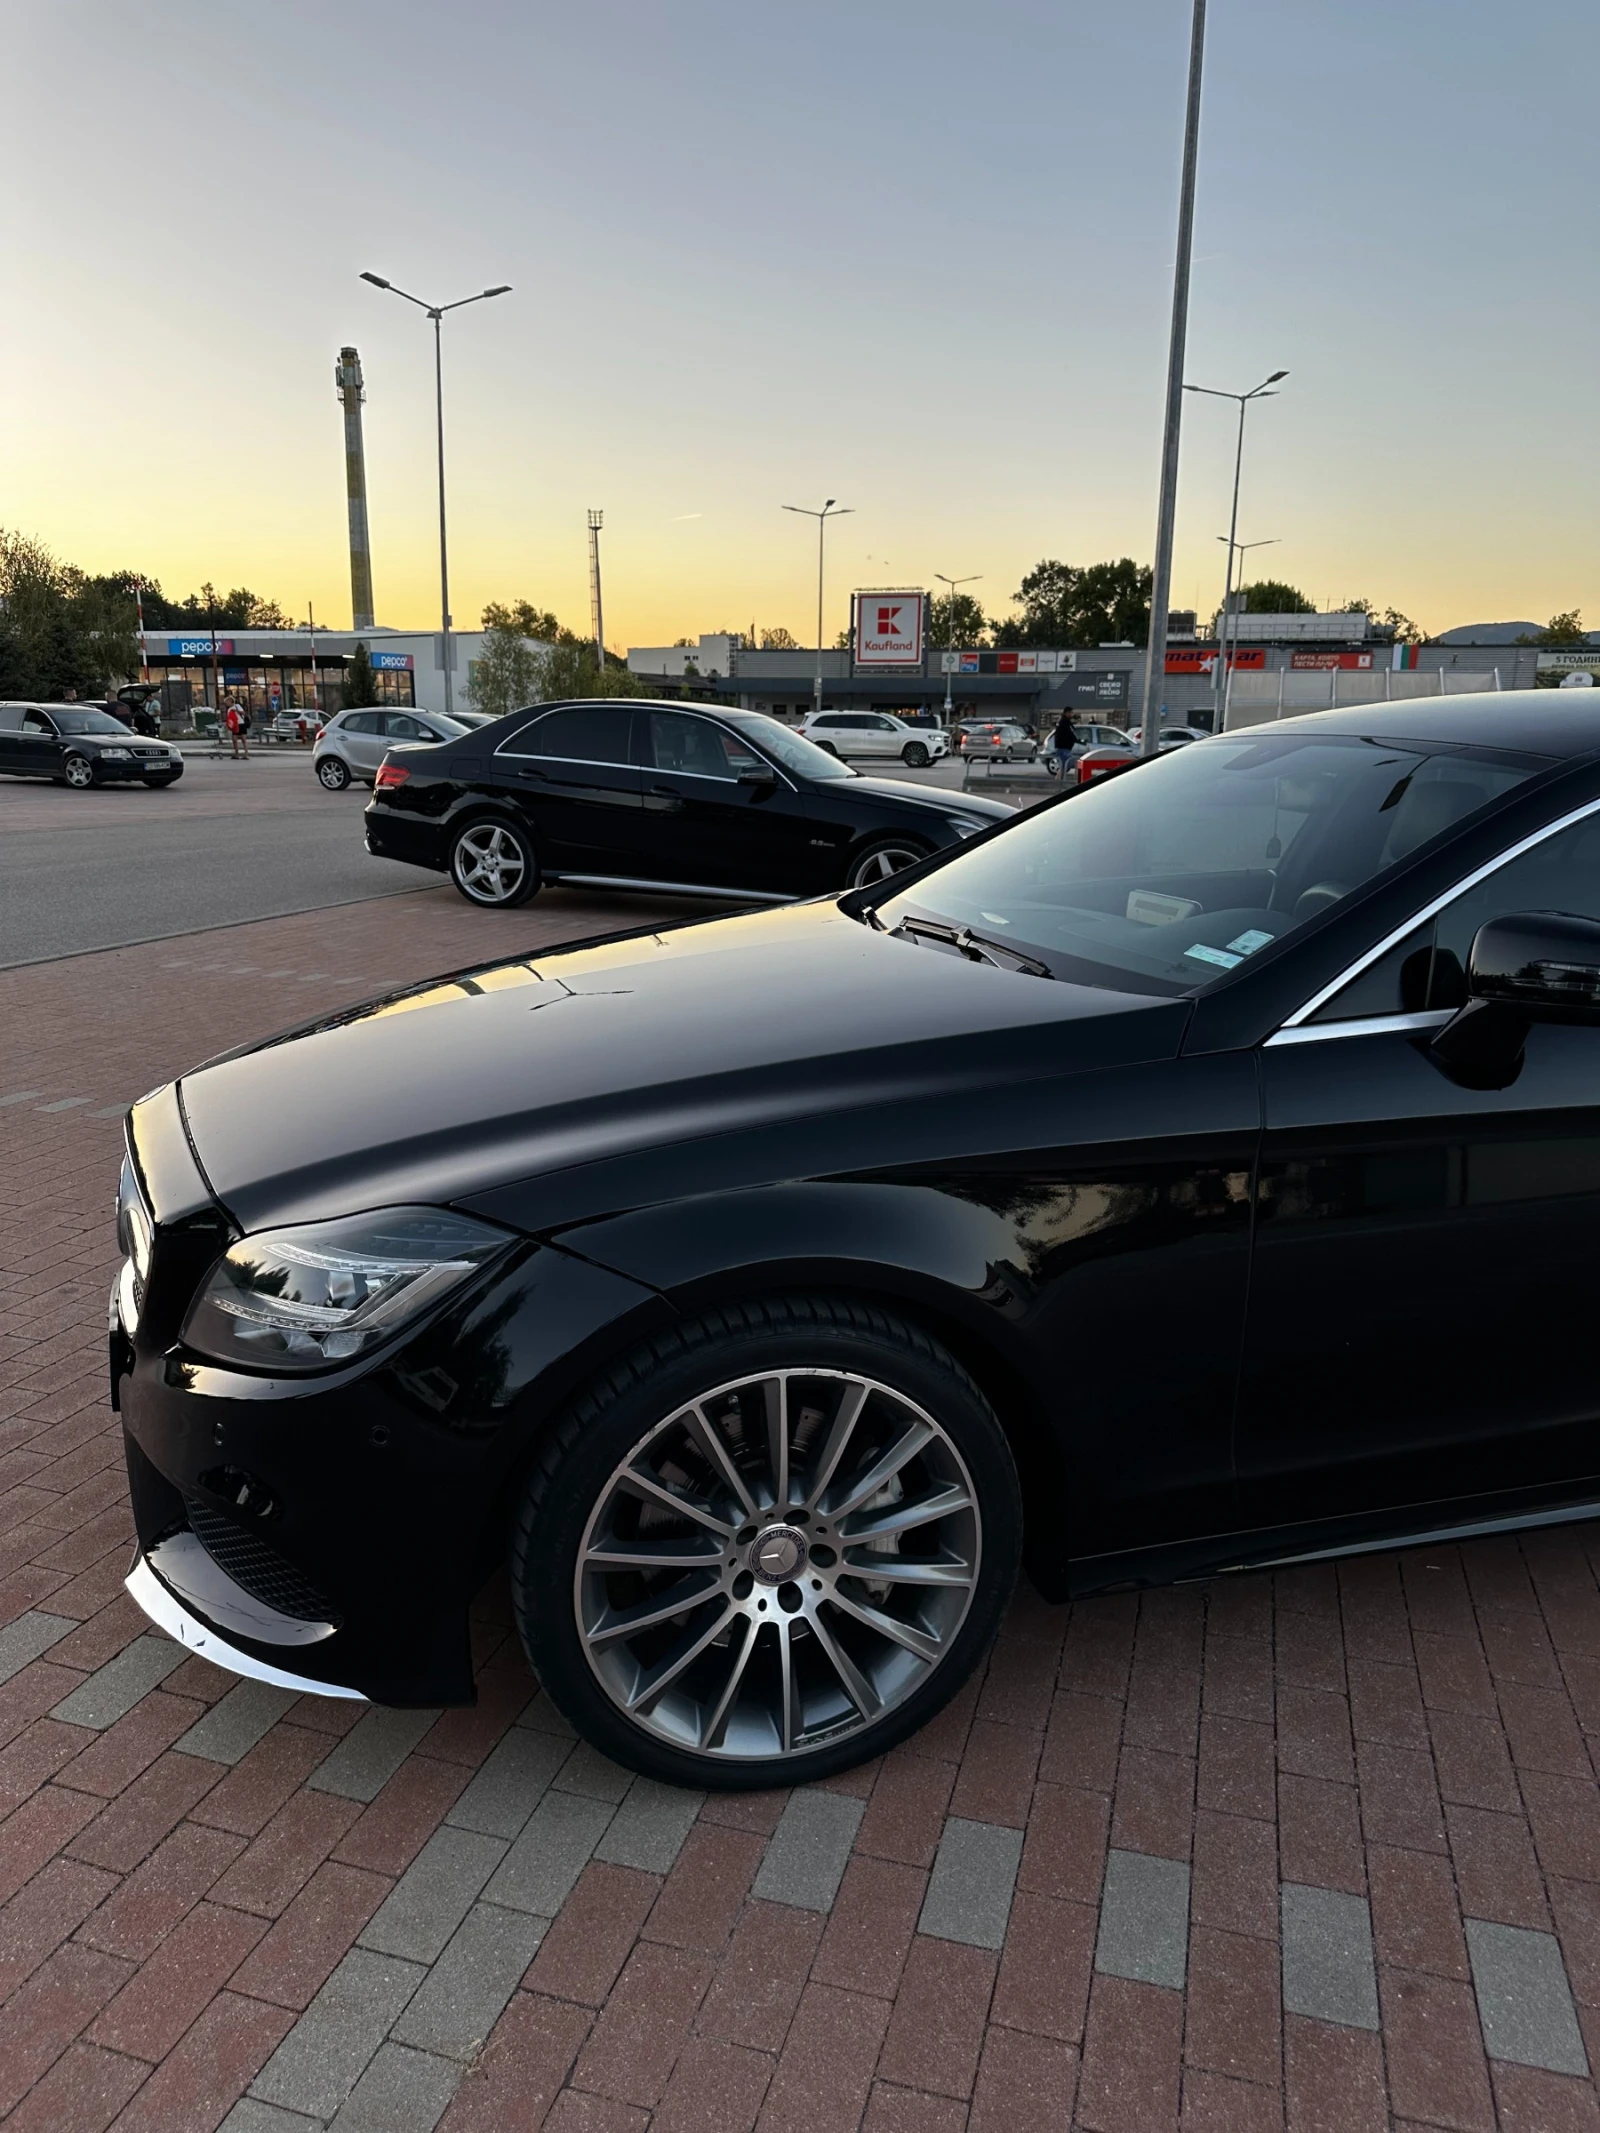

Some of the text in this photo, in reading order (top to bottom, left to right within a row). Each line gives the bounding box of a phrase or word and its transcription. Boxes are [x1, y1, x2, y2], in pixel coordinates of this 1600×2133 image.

[181, 641, 219, 653] pepco
[865, 640, 913, 651] Kaufland
[381, 656, 406, 668] pepco
[770, 1530, 806, 1552] MERCEDES
[757, 1568, 778, 1582] BENZ
